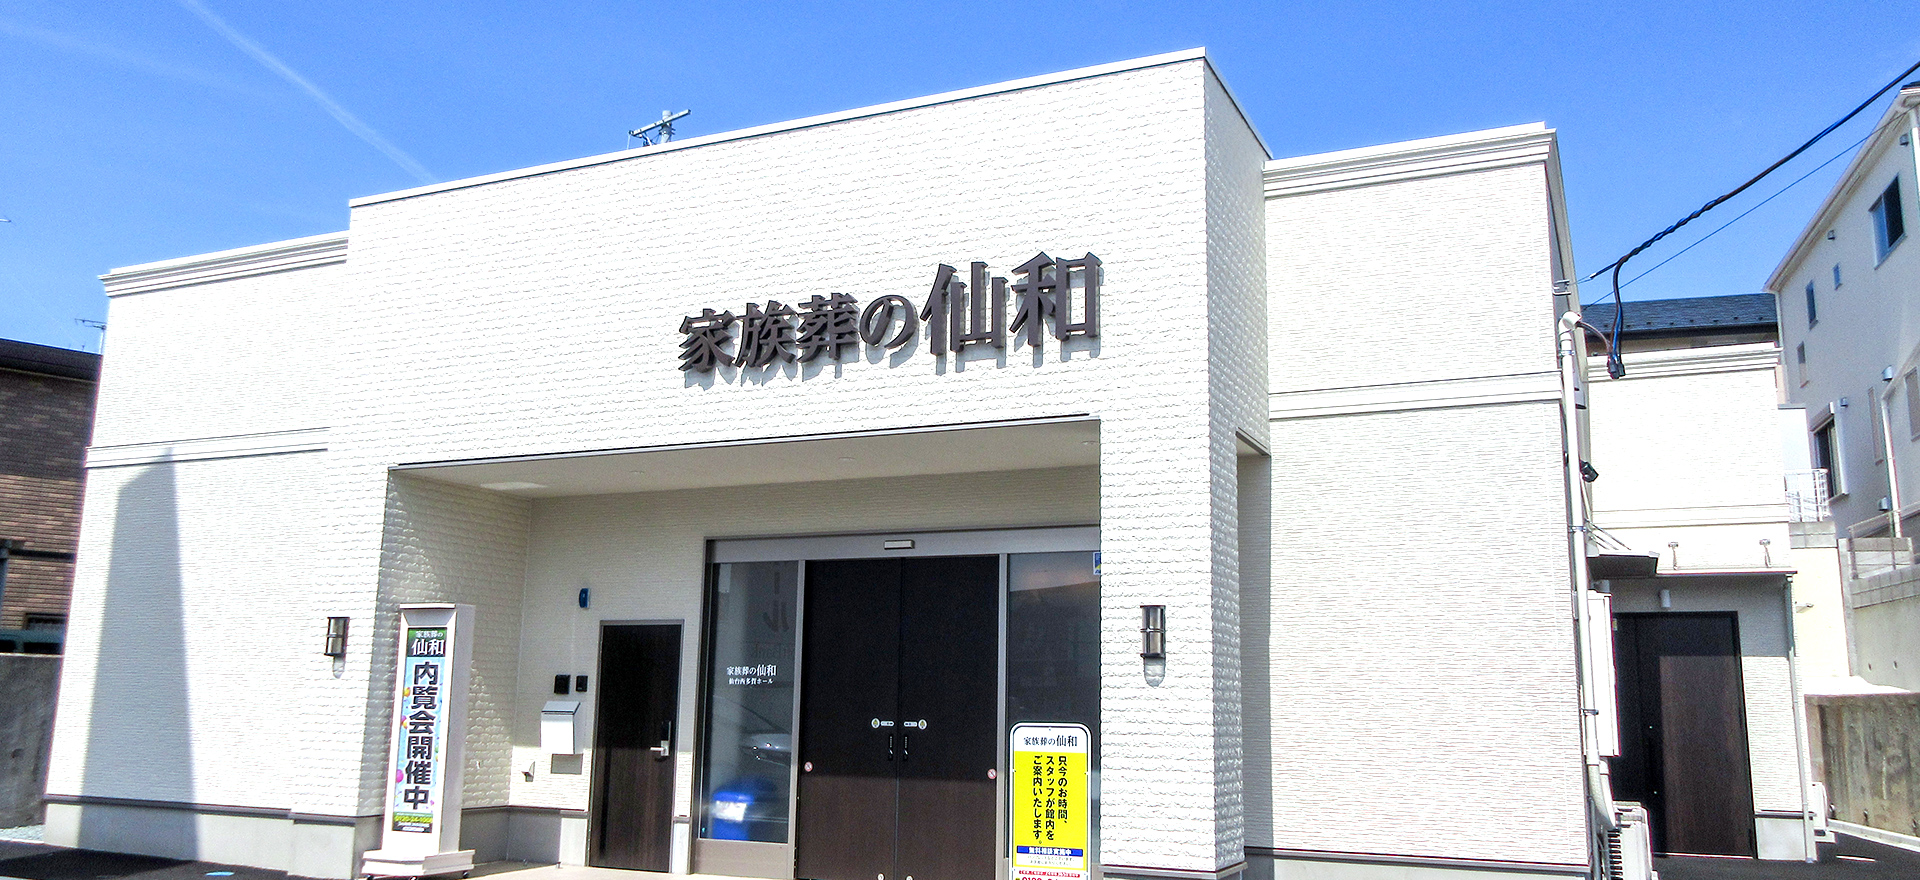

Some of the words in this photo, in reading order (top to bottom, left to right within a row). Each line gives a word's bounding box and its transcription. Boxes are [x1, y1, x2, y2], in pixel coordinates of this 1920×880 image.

[679, 251, 1102, 371] 家族葬の仙和
[411, 638, 445, 656] 仙和
[727, 664, 777, 676] 家族葬の仙和
[404, 661, 439, 810] 内覧会開催中
[1023, 734, 1078, 747] 家族葬の仙和
[1033, 754, 1043, 845] ご案内いたします。
[1046, 755, 1055, 841] スタッフが館内を
[1058, 755, 1068, 824] 只今のお時間、
